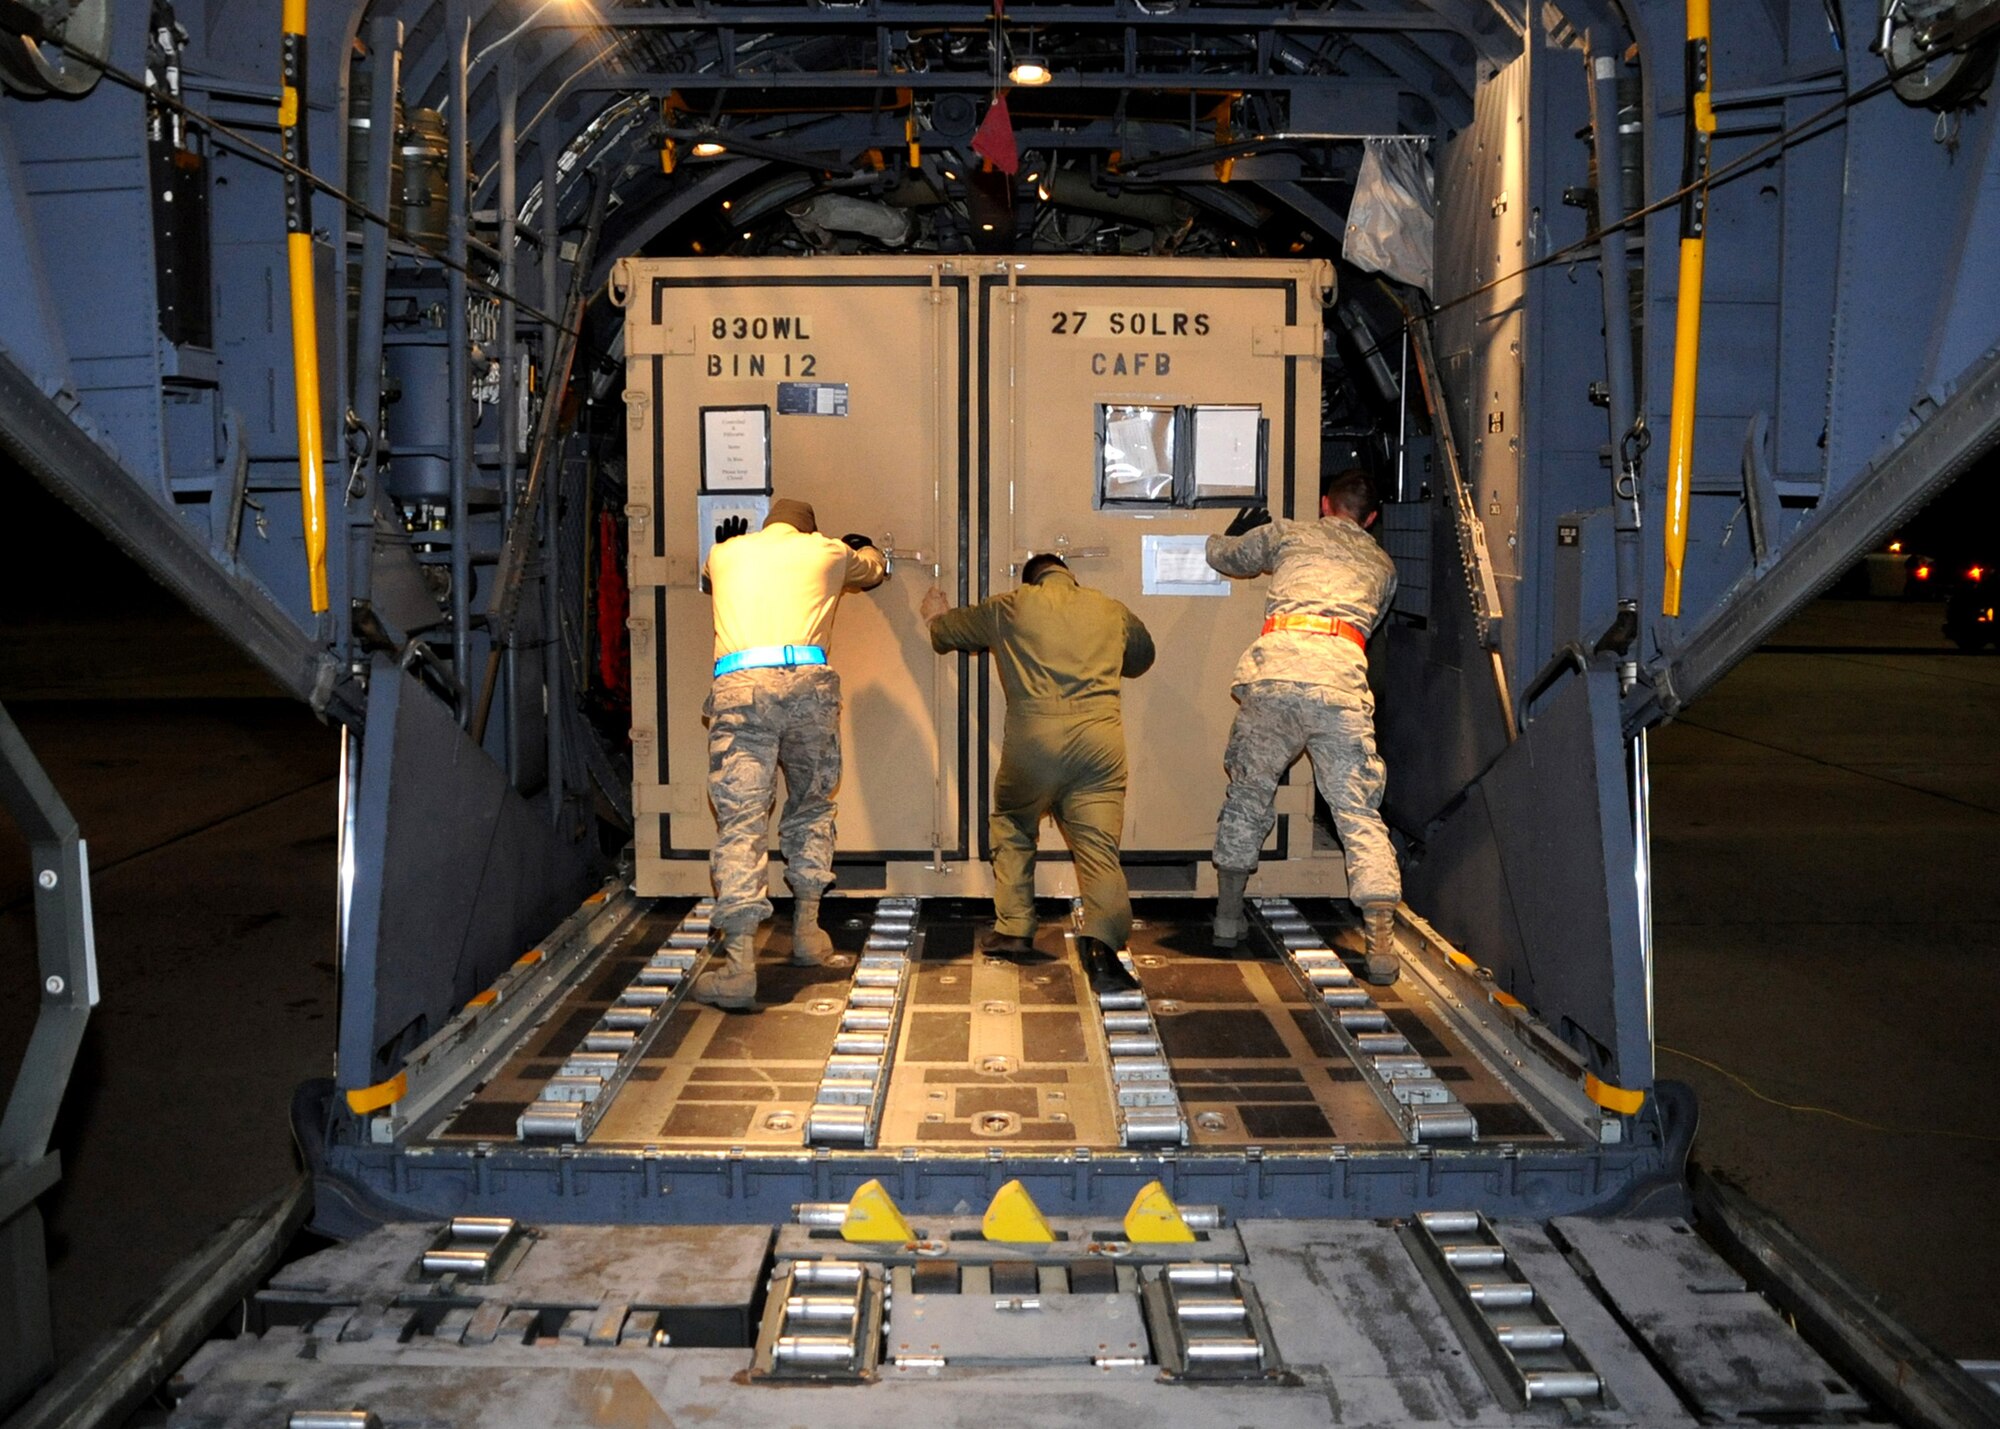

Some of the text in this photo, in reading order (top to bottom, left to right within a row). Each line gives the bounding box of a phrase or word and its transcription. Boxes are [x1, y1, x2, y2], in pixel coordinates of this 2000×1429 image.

[1051, 312, 1210, 336] 27 SOLRS
[707, 354, 816, 377] BIN 12
[1092, 353, 1170, 375] CAFB
